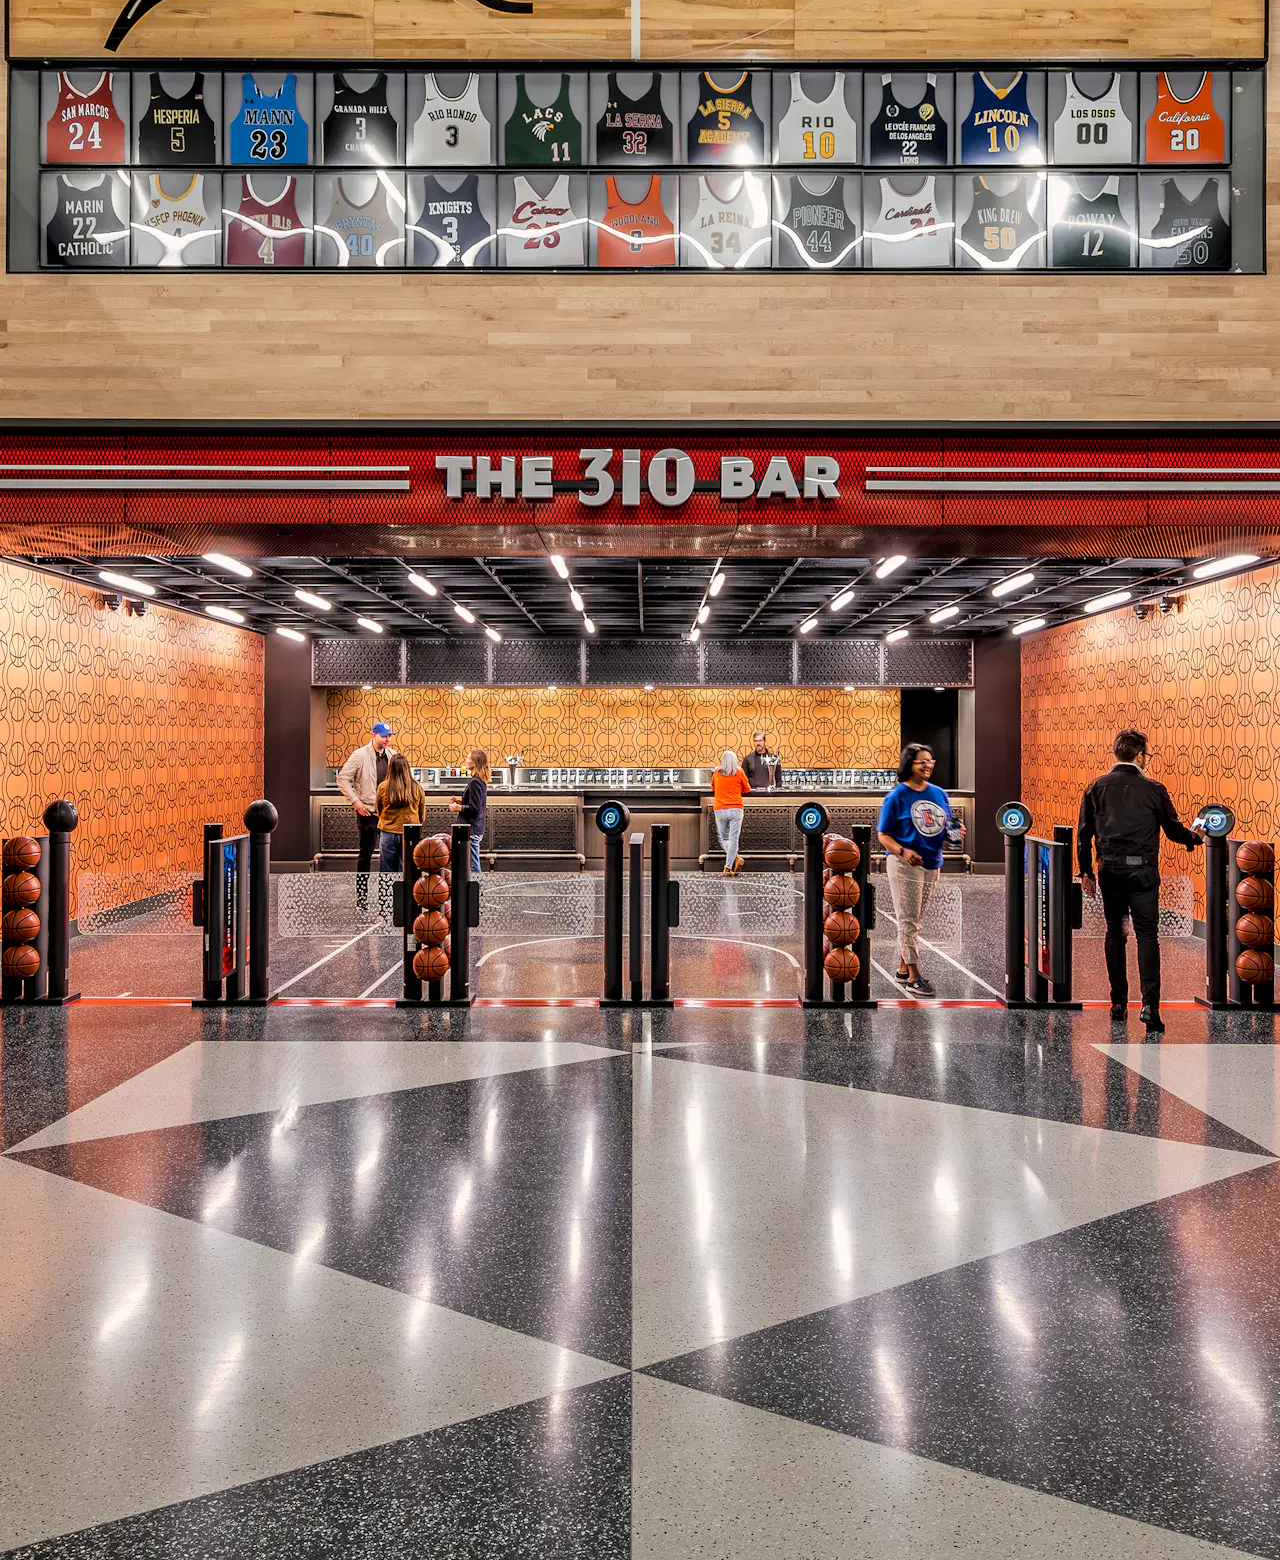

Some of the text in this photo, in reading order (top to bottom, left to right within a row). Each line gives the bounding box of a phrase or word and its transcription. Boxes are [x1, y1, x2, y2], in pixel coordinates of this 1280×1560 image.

[61, 103, 109, 122] SAN MARCOS
[154, 109, 200, 124] HESPERIA
[244, 110, 295, 125] MANN
[334, 105, 387, 114] GRANADA HILLS
[428, 109, 478, 123] RIO HONDO
[522, 108, 564, 124] LACS
[974, 109, 1029, 127] LINCOLN
[1071, 109, 1115, 118] LOS OSOS
[1158, 111, 1211, 125] California
[606, 113, 662, 128] LA SERNA
[802, 116, 834, 127] RIO
[68, 121, 102, 150] 24
[171, 128, 185, 152] 5
[623, 131, 647, 155] 32
[987, 125, 1020, 152] 10
[1076, 123, 1108, 144] 00
[1170, 128, 1199, 151] 20
[251, 130, 287, 160] 23
[551, 142, 570, 162] 11
[802, 131, 835, 159] 10
[65, 200, 103, 214] MARIN
[429, 202, 472, 215] KNIGHTS
[73, 217, 93, 238] 22
[334, 216, 383, 231] CRYSTAL
[793, 205, 845, 231] PIONEER
[984, 227, 1015, 250] 50
[436, 448, 841, 506] THE 310 BAR
